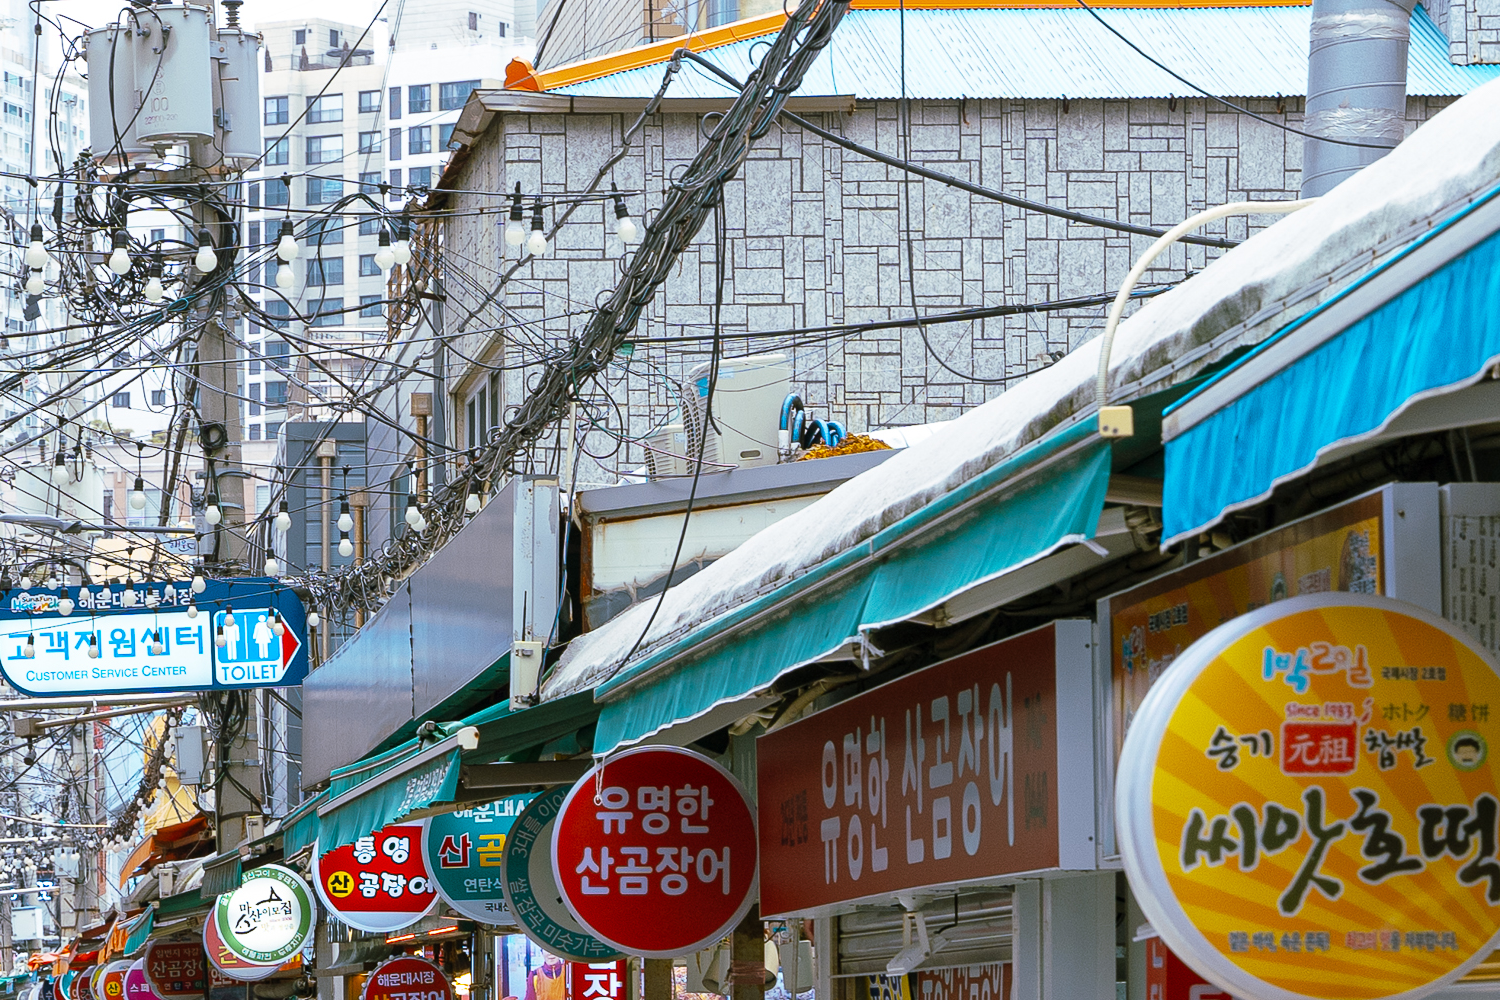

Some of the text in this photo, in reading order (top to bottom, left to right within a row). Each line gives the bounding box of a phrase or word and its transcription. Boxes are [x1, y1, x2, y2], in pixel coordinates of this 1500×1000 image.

[7, 625, 204, 661] 고객지원센터
[222, 664, 278, 681] TOILET
[1264, 642, 1373, 692] 1박2일
[1208, 728, 1273, 769] 승기
[1287, 735, 1353, 766] 元祖
[1366, 728, 1432, 769] 찹쌀
[821, 714, 890, 885] 유명한
[902, 670, 1016, 864] 산곰장어
[596, 784, 714, 835] 유명한
[330, 875, 350, 894] 산
[575, 846, 731, 896] 산곰장어
[239, 901, 292, 922] 마산이모집
[108, 985, 119, 995] 산
[377, 971, 435, 987] 해운대시장
